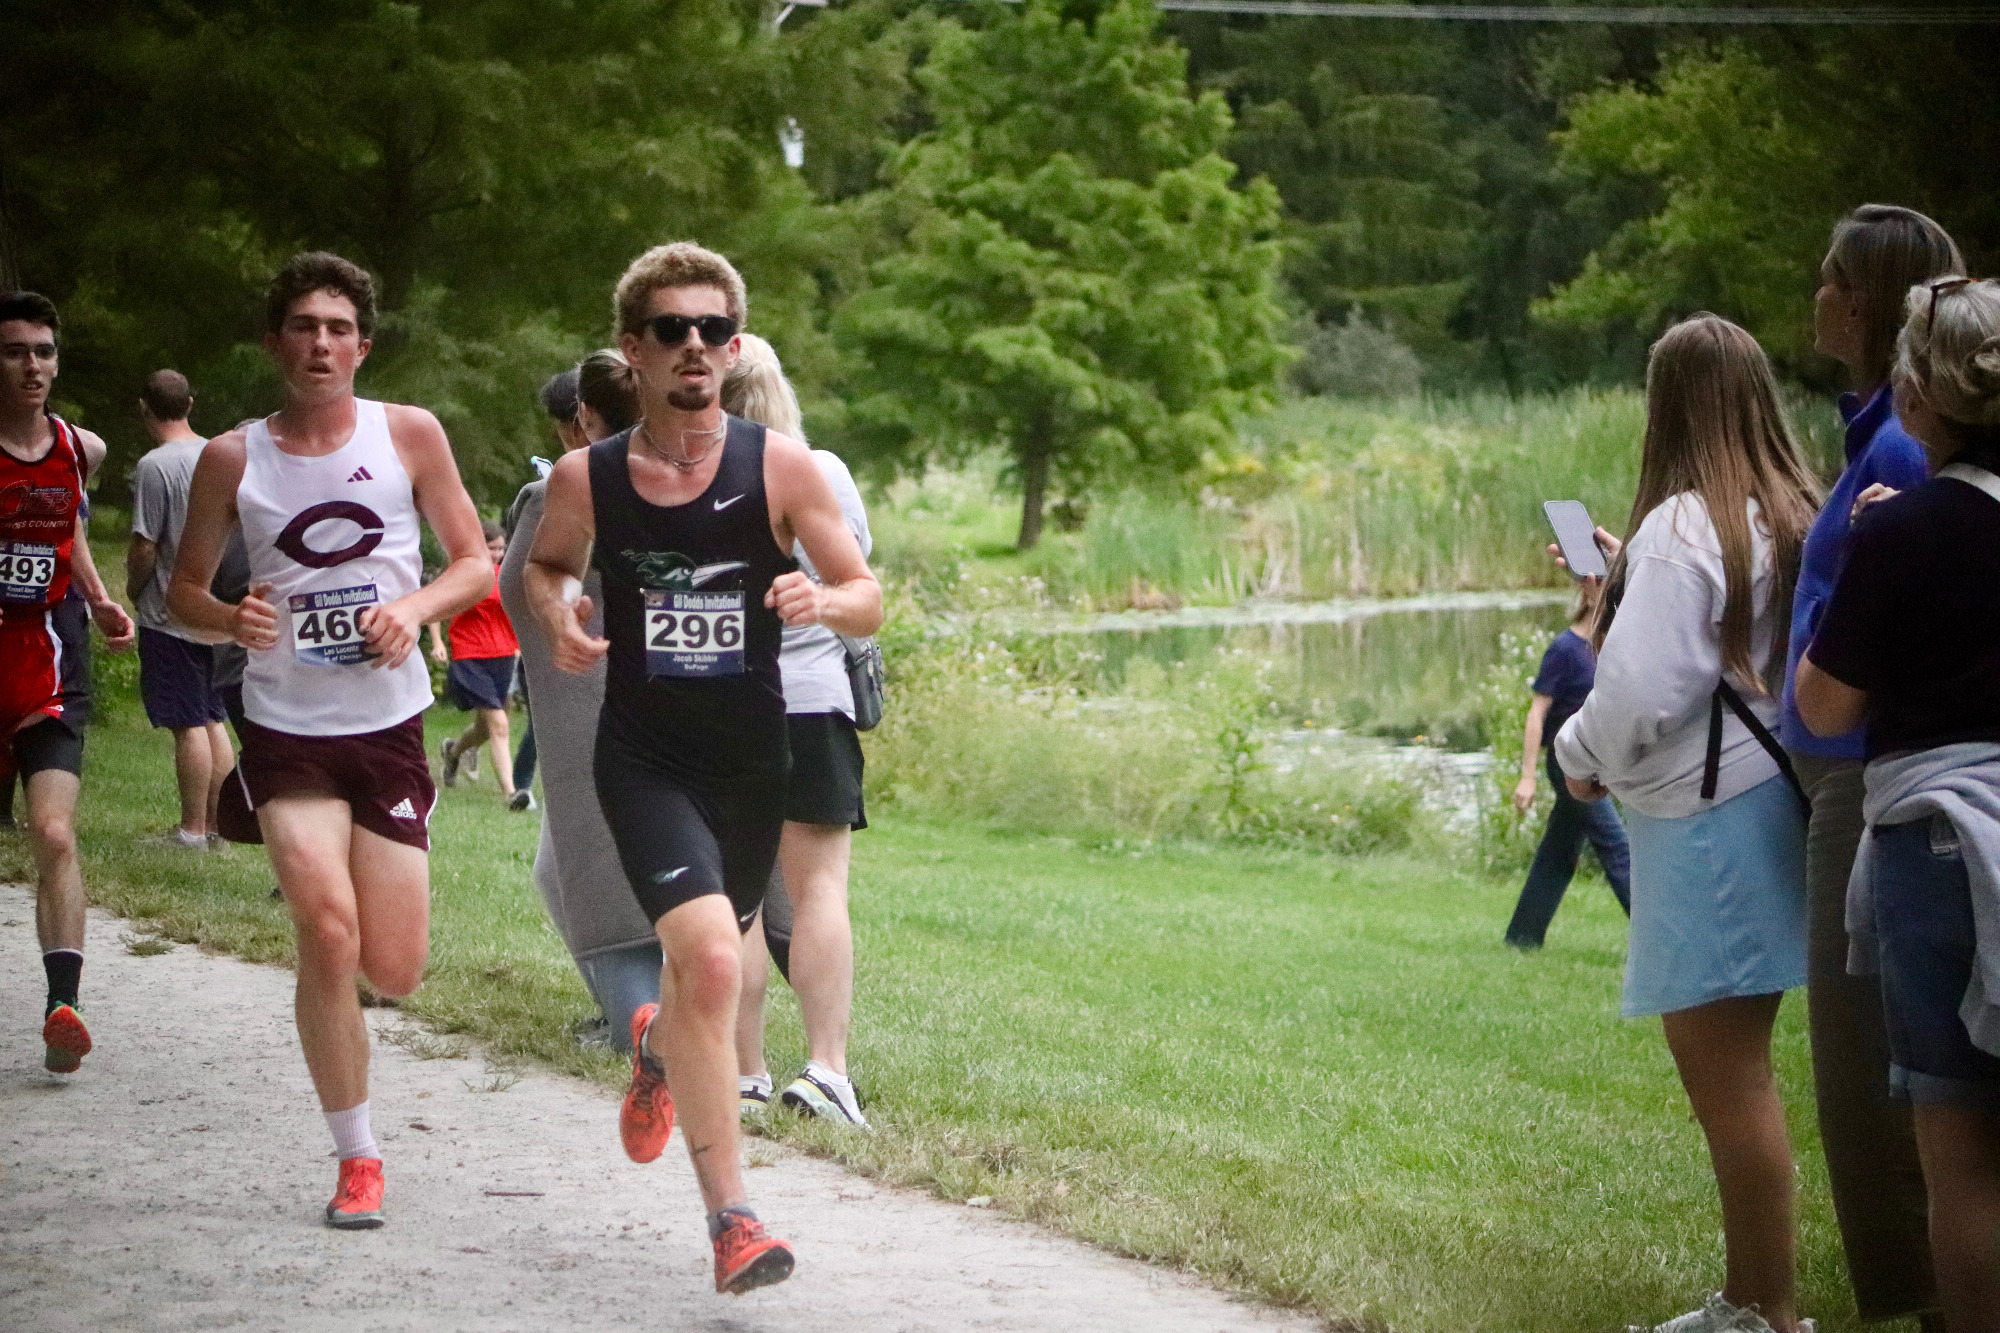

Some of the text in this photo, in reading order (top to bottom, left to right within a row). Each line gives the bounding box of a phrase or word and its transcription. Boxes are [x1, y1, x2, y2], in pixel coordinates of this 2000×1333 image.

[28, 520, 69, 529] COUNTRY
[0, 555, 51, 584] 493
[314, 594, 323, 608] Gil
[323, 592, 342, 607] Dodds
[342, 587, 376, 604] Invitational
[673, 594, 741, 609] Gil Dodds Invitational
[650, 613, 741, 649] 296
[323, 648, 335, 656] Leo
[673, 653, 693, 662] Jacob
[684, 663, 709, 671] DuPage
[389, 809, 418, 820] adidas
